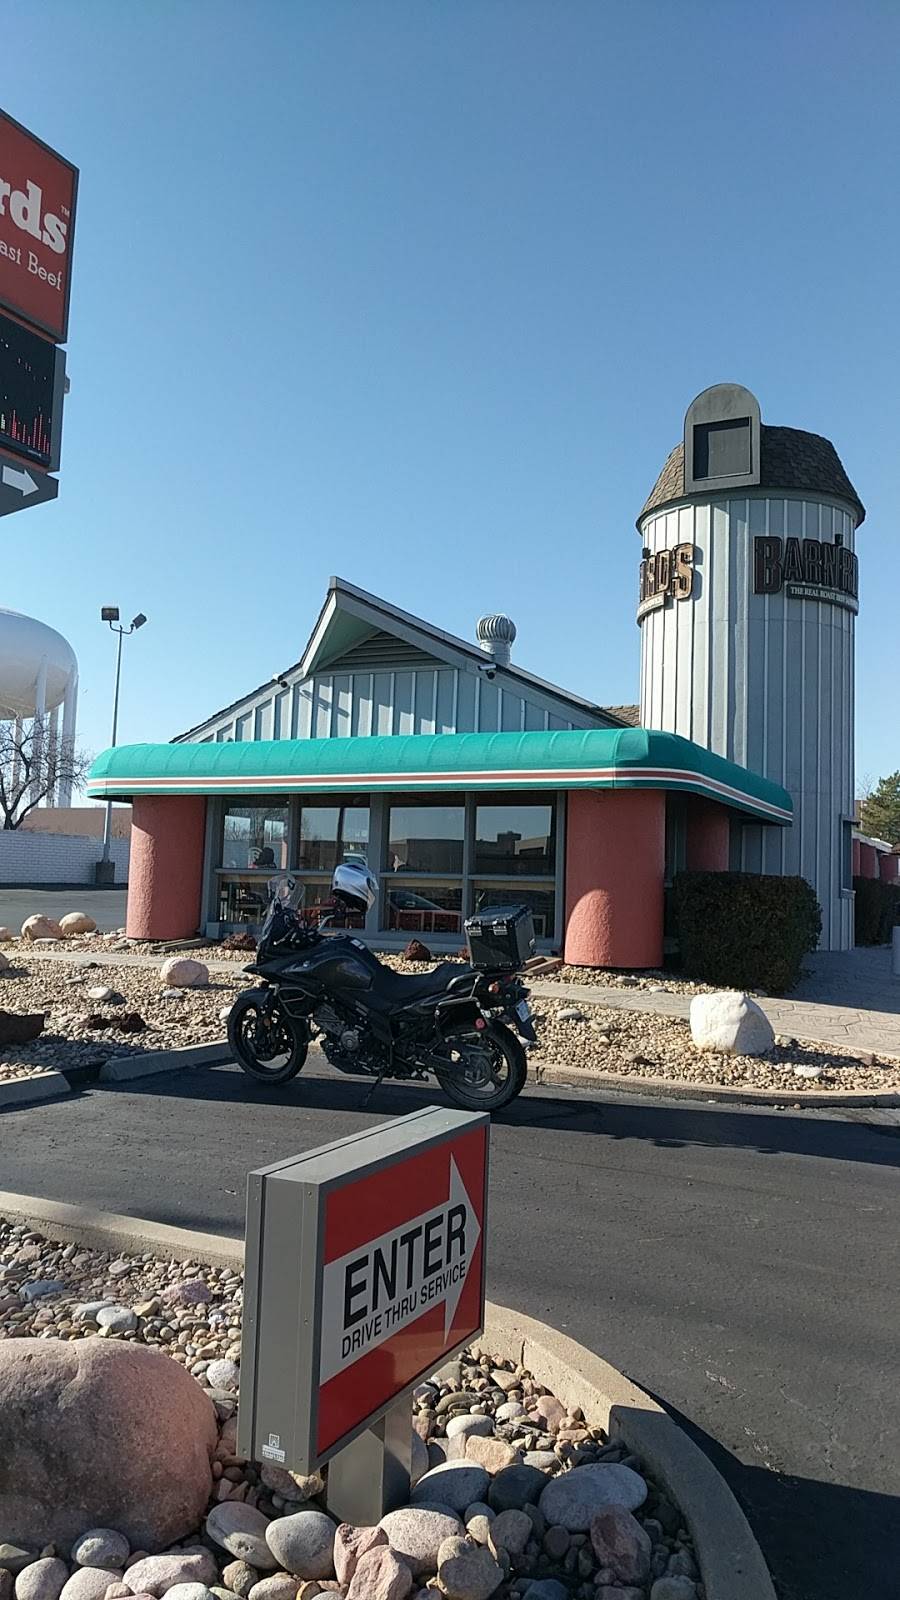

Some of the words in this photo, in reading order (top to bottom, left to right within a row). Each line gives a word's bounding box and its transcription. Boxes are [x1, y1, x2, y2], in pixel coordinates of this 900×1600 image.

[27, 251, 62, 291] Beef
[790, 586, 805, 595] THE
[804, 587, 819, 597] REAL
[344, 1203, 467, 1330] ENTER
[341, 1314, 382, 1359] DRIVE
[384, 1291, 417, 1329] THRU
[420, 1260, 466, 1304] SERVICE
